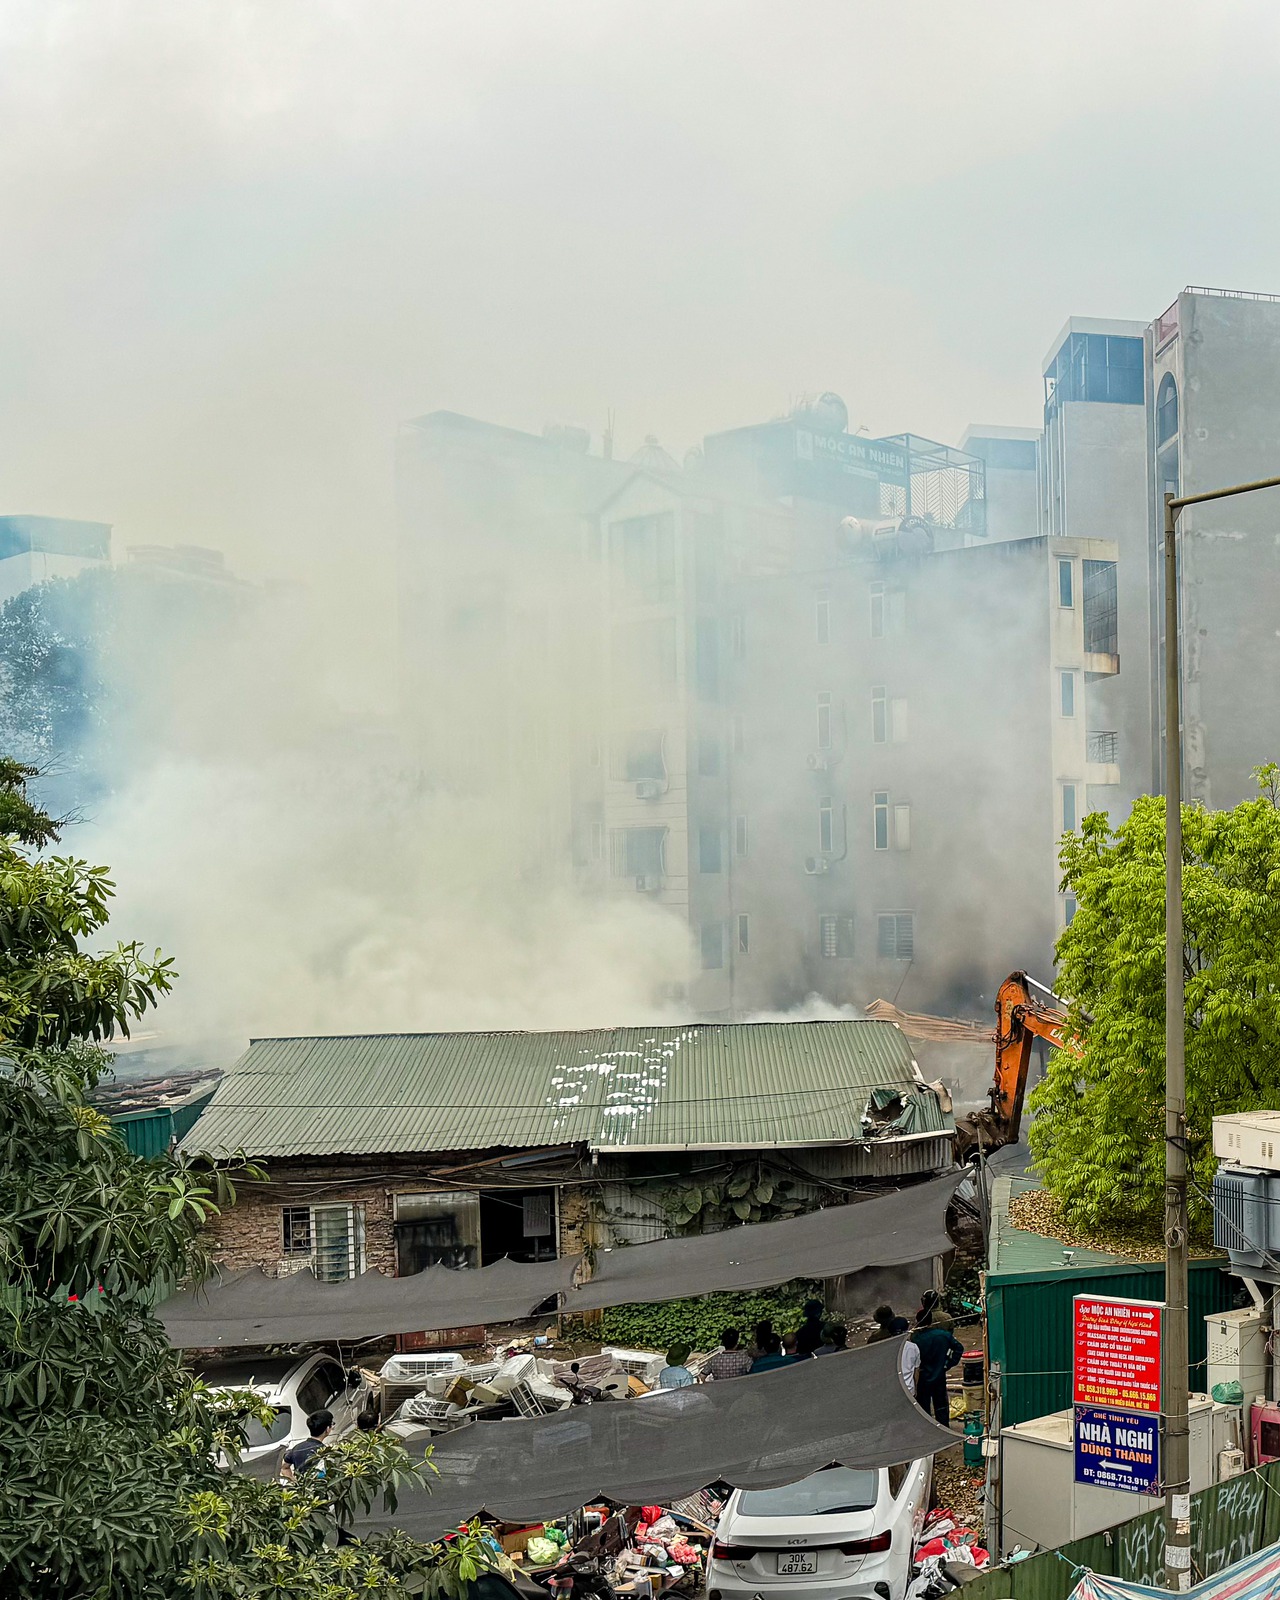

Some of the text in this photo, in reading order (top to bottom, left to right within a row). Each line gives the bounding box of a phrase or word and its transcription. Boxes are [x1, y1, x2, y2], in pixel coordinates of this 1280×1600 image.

[848, 444, 866, 458] AN
[869, 448, 904, 468] NHIÊN
[1091, 1304, 1104, 1316] MỘC
[1105, 1307, 1112, 1316] AN
[1114, 1307, 1130, 1318] NHIÊN
[1108, 1414, 1124, 1422] TÌNH
[1126, 1417, 1139, 1425] YÊU
[1080, 1422, 1153, 1451] NHÀ NGHỈ
[1081, 1442, 1152, 1464] DŨNG THÀNH
[1084, 1468, 1149, 1486] ĐT: 0868.713.916
[789, 1554, 806, 1563] 30K
[782, 1563, 813, 1573] 487.62
